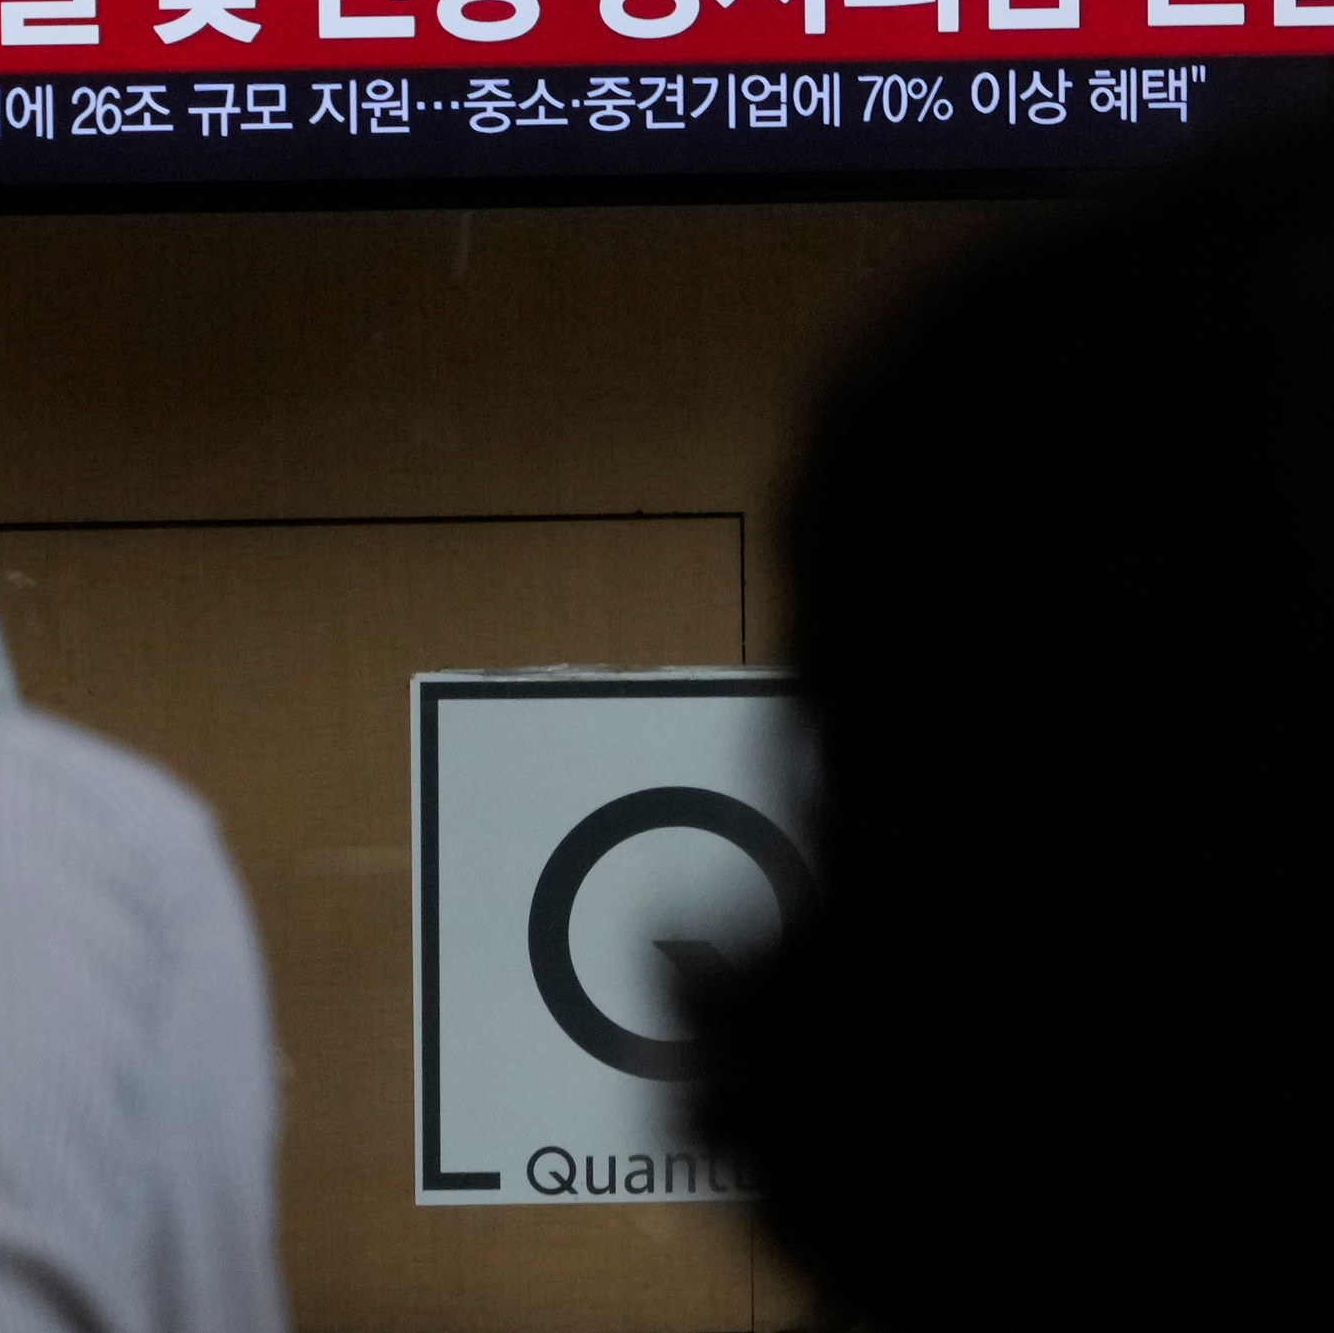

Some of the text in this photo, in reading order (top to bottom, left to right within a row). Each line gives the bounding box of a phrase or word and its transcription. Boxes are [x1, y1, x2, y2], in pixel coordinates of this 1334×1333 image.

[70, 84, 175, 136] 26조
[187, 82, 294, 138] 규모
[857, 73, 955, 124] 70%
[970, 67, 1074, 126] 이상
[1087, 64, 1207, 124] 혜택"
